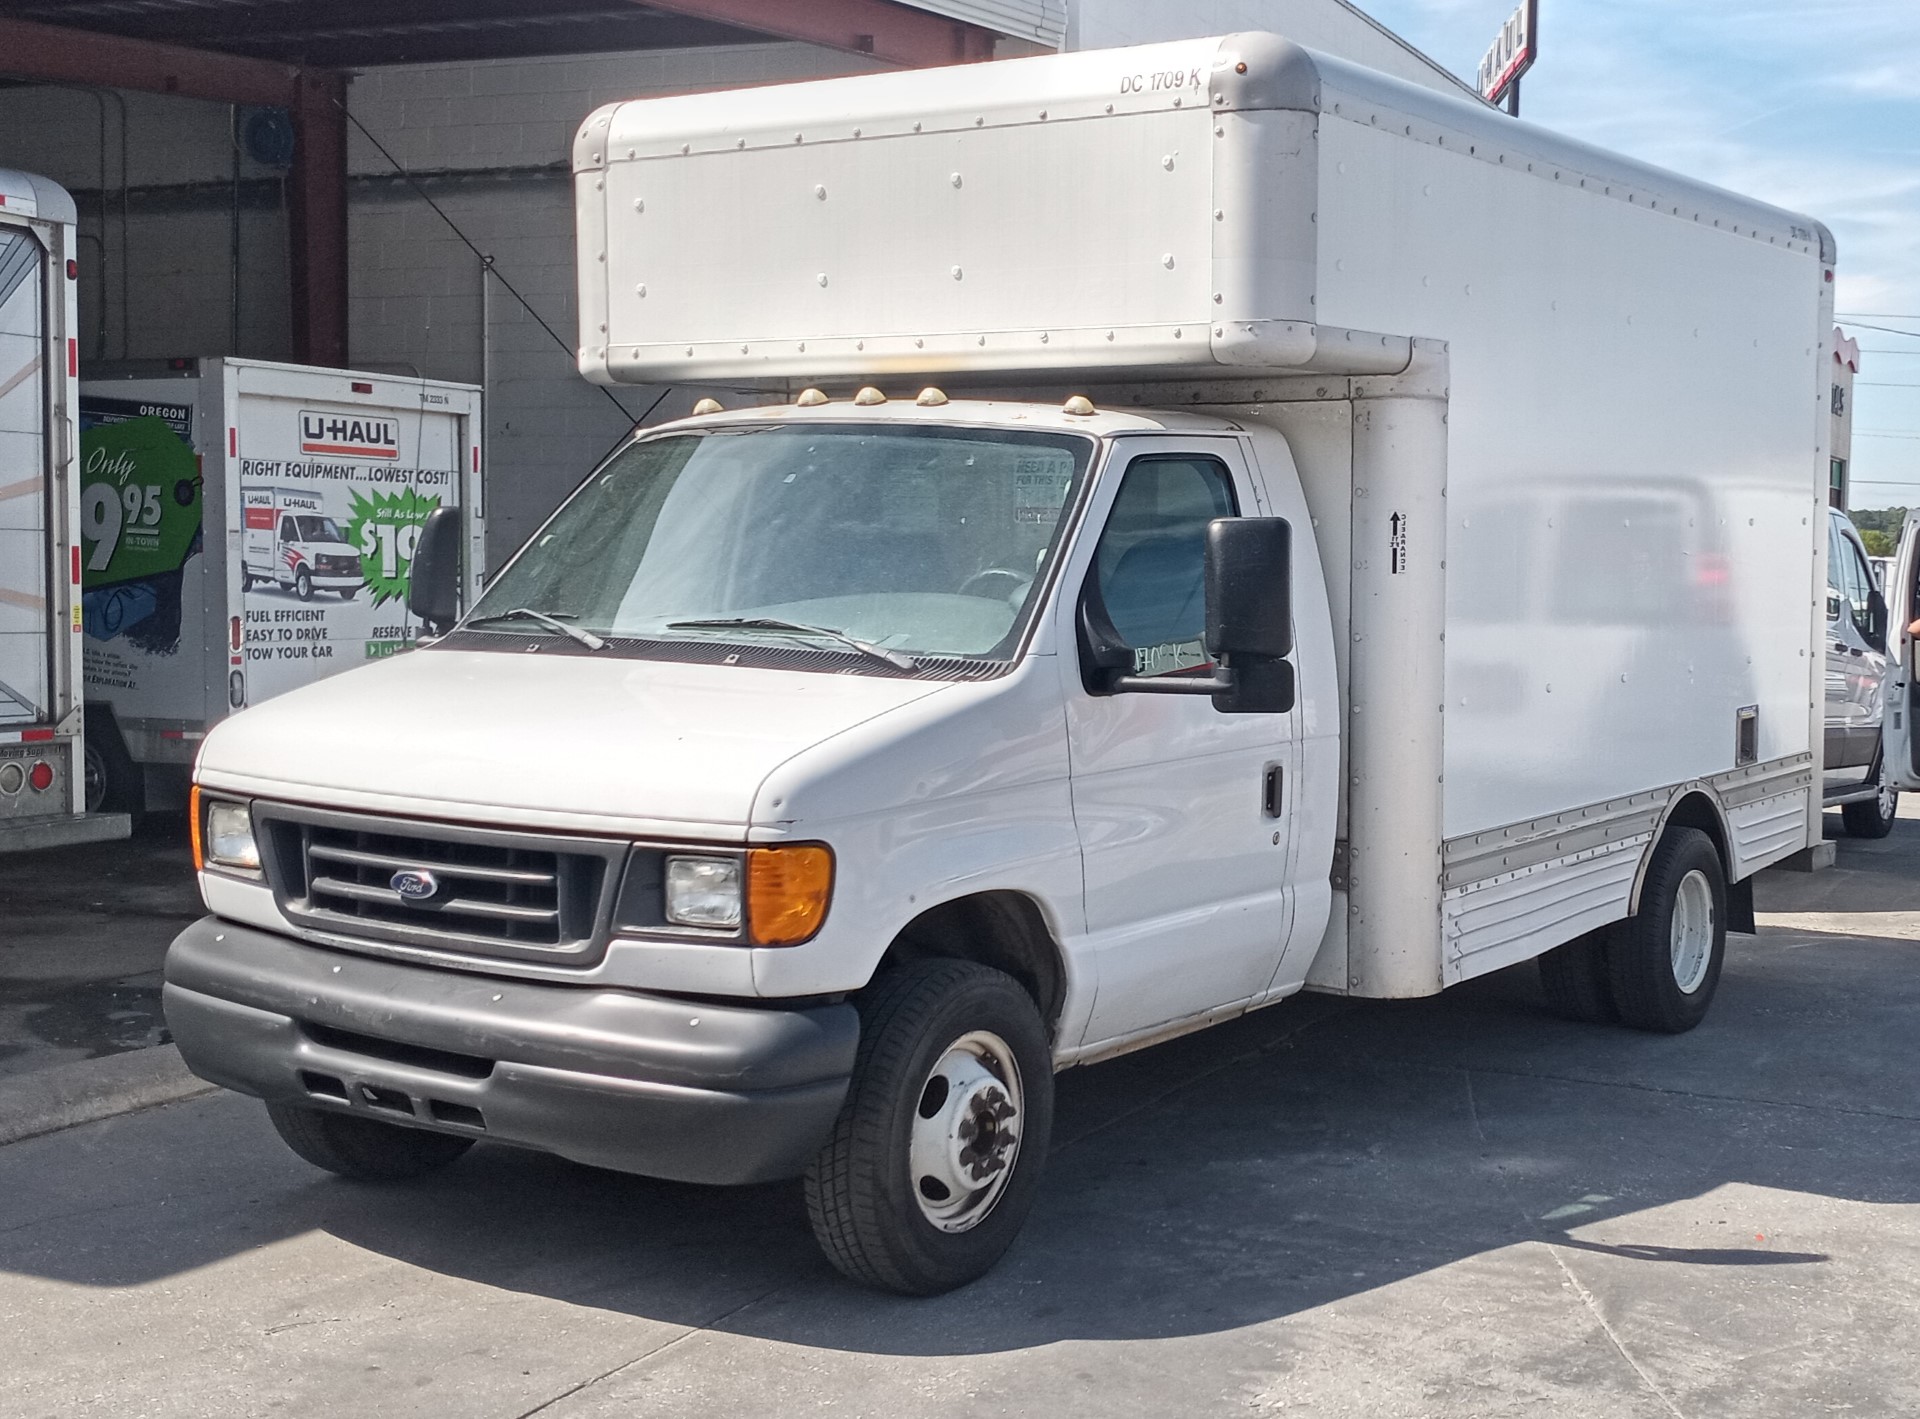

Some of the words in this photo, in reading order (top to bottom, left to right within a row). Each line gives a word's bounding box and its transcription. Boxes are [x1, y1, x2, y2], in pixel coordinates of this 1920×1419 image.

[1120, 74, 1143, 94] DC
[1150, 70, 1184, 91] 1709
[1188, 67, 1202, 87] K
[139, 404, 186, 419] OREGON
[303, 416, 396, 446] U-HAUL
[86, 446, 137, 487] Only
[242, 460, 282, 477] RIGHT
[417, 469, 449, 485] COST!
[283, 497, 317, 510] U-HAUL
[376, 507, 392, 518] Still
[394, 508, 405, 519] As
[406, 510, 424, 520] Low
[125, 536, 160, 548] IN-TOWN
[245, 610, 272, 623] FUEL
[274, 609, 326, 622] EFFICIENT
[246, 629, 275, 642] EASY
[277, 628, 293, 641] TO
[296, 627, 329, 640] DRIVE
[372, 626, 412, 639] RESERVE
[245, 647, 274, 660] TOW
[276, 646, 308, 659] YOUR
[311, 645, 334, 658] CAR
[1172, 643, 1185, 668] K
[400, 876, 425, 894] Ford
